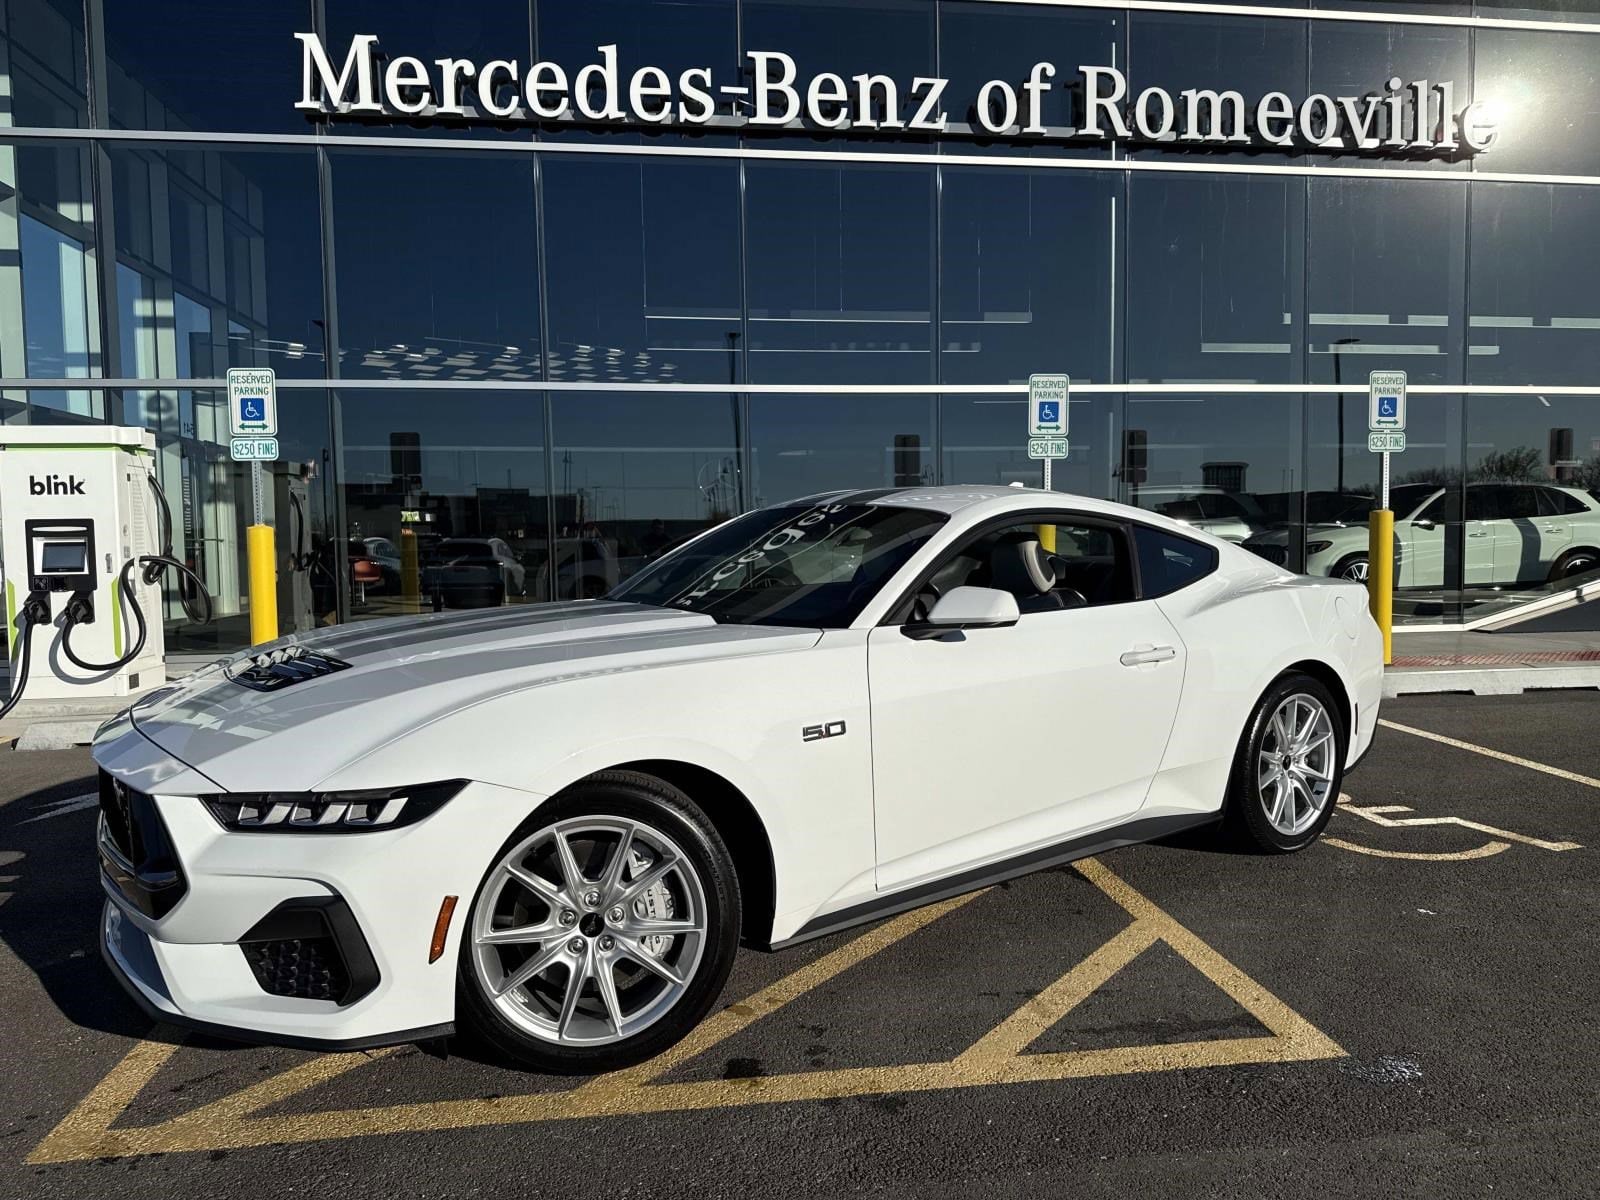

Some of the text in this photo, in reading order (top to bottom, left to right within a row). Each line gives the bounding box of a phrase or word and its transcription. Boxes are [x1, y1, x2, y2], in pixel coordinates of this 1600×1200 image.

[293, 32, 1498, 150] Mercedes-Benz of Romeoville
[231, 375, 271, 384] RESERVED
[1032, 380, 1066, 389] RESERVED
[1372, 376, 1404, 385] RESERVED
[234, 386, 269, 396] PARKING
[1034, 391, 1064, 399] PARKING
[1374, 387, 1402, 395] PARKING
[1371, 436, 1403, 448] $250 FINE
[234, 442, 275, 456] $250 FINE
[1031, 442, 1065, 455] $250 FINE
[29, 474, 86, 495] blink
[803, 720, 846, 742] 5.0
